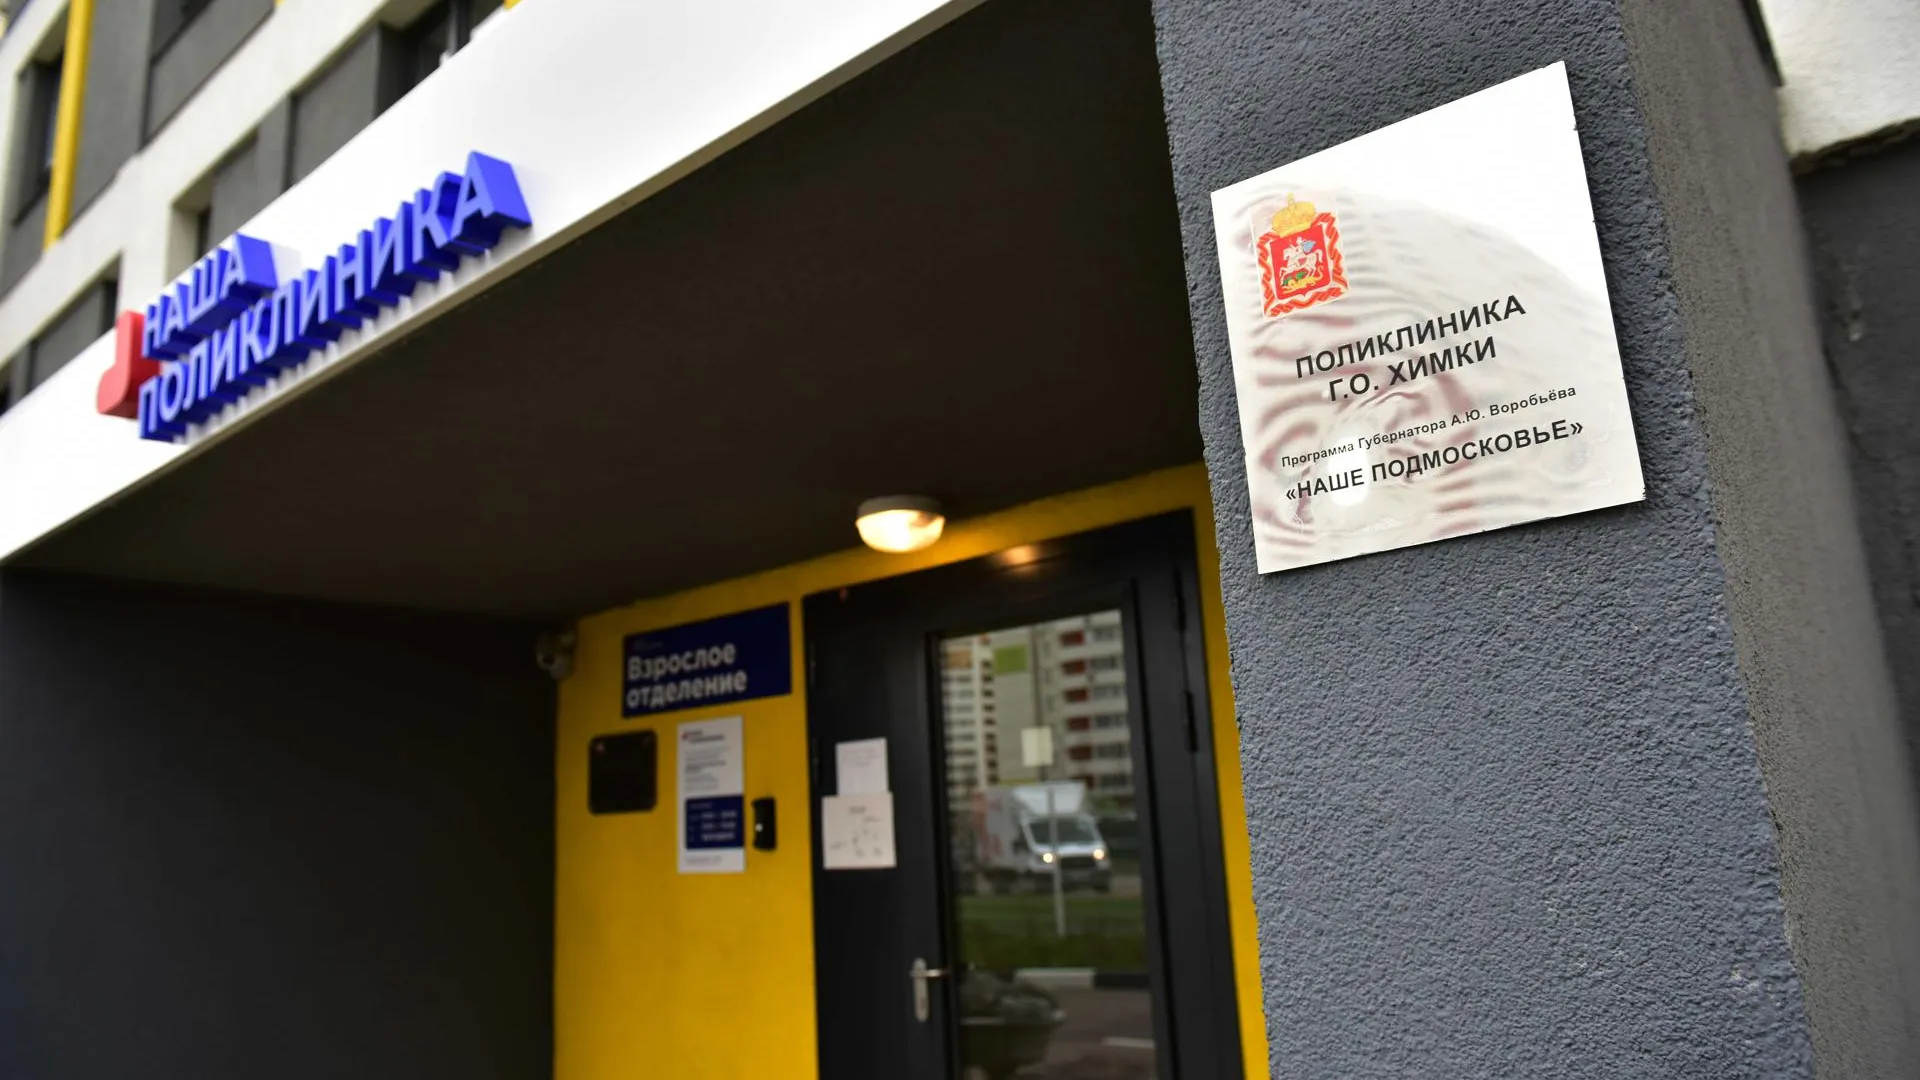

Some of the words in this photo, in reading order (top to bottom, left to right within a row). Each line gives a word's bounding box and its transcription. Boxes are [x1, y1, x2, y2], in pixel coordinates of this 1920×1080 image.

[138, 151, 515, 439] ПОЛИКЛИНИКА
[142, 232, 268, 358] НАША
[1296, 294, 1526, 378] ПОЛИКЛИНИКА
[1328, 372, 1379, 402] Г.О.
[1387, 335, 1497, 386] ХИМКИ
[1281, 441, 1354, 468] Программа
[1358, 419, 1447, 450] Губернатора
[1450, 409, 1486, 427] А.Ю.
[1490, 386, 1577, 417] Воробьёва
[1284, 468, 1365, 501] «НАШЕ
[1371, 419, 1584, 483] ПОДМОСКОВЬЕ»
[626, 670, 748, 709] отделение
[627, 642, 736, 681] Взрослое
